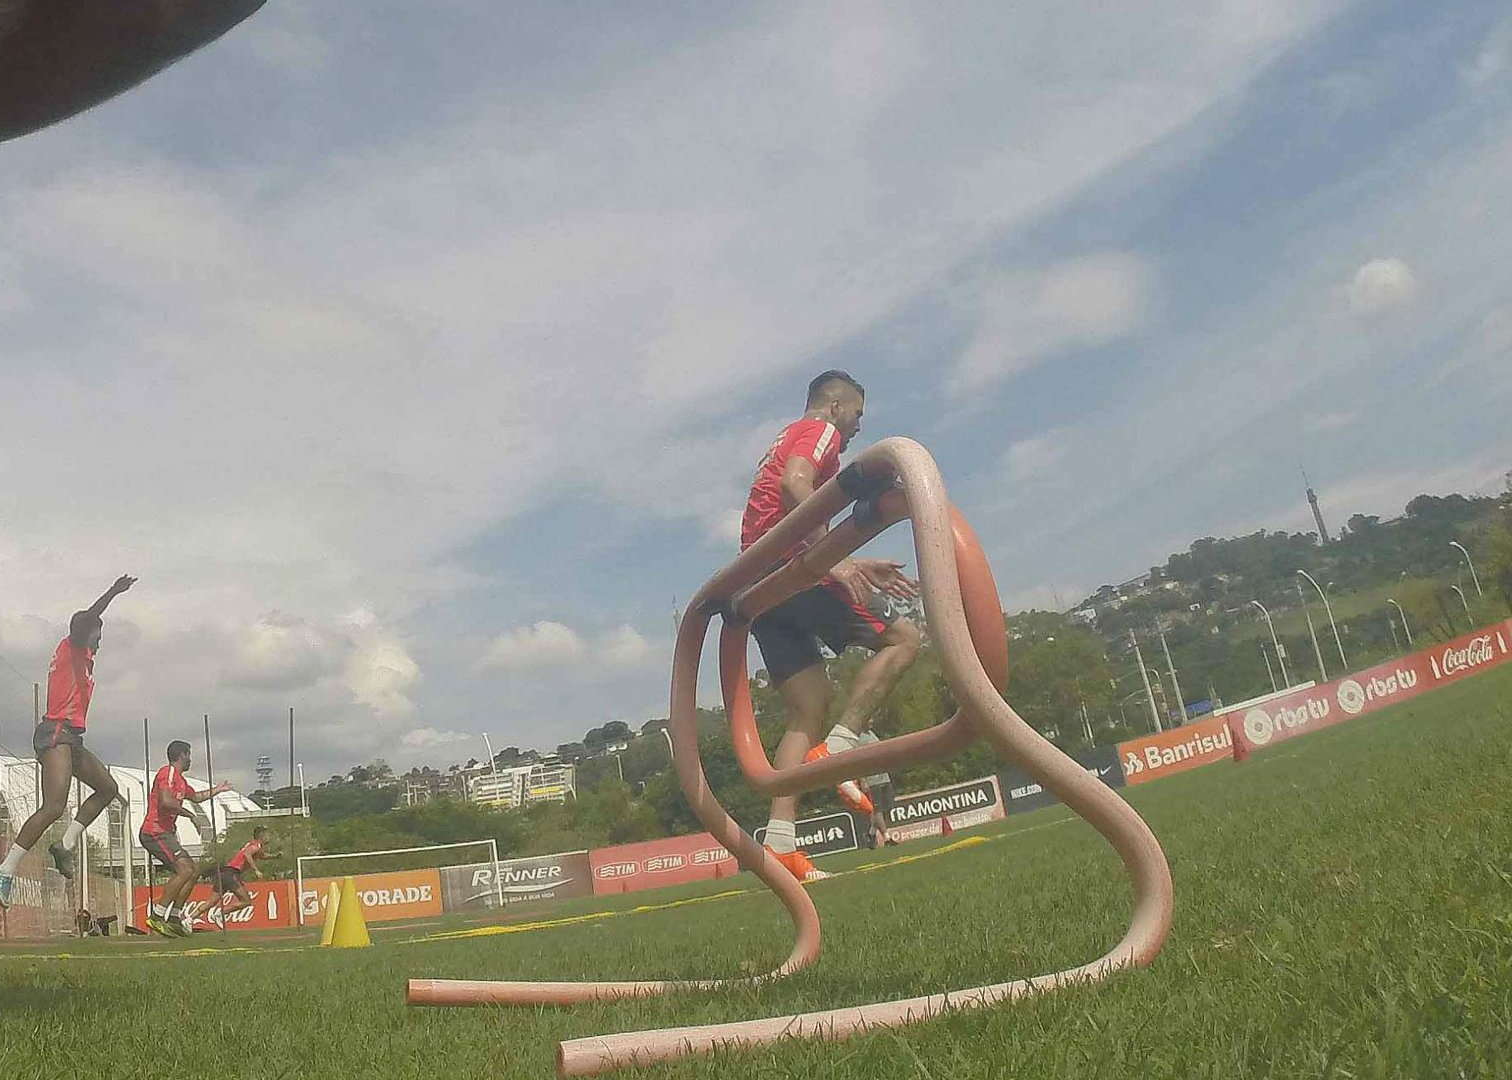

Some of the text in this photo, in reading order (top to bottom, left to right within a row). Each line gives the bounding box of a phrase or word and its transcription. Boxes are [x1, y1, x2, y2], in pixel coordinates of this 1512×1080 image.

[1144, 723, 1233, 770] Banrisul
[890, 788, 989, 823] TRAMONTINA
[615, 864, 636, 875] TIM
[663, 857, 683, 868] TIM
[471, 865, 562, 887] RENNER
